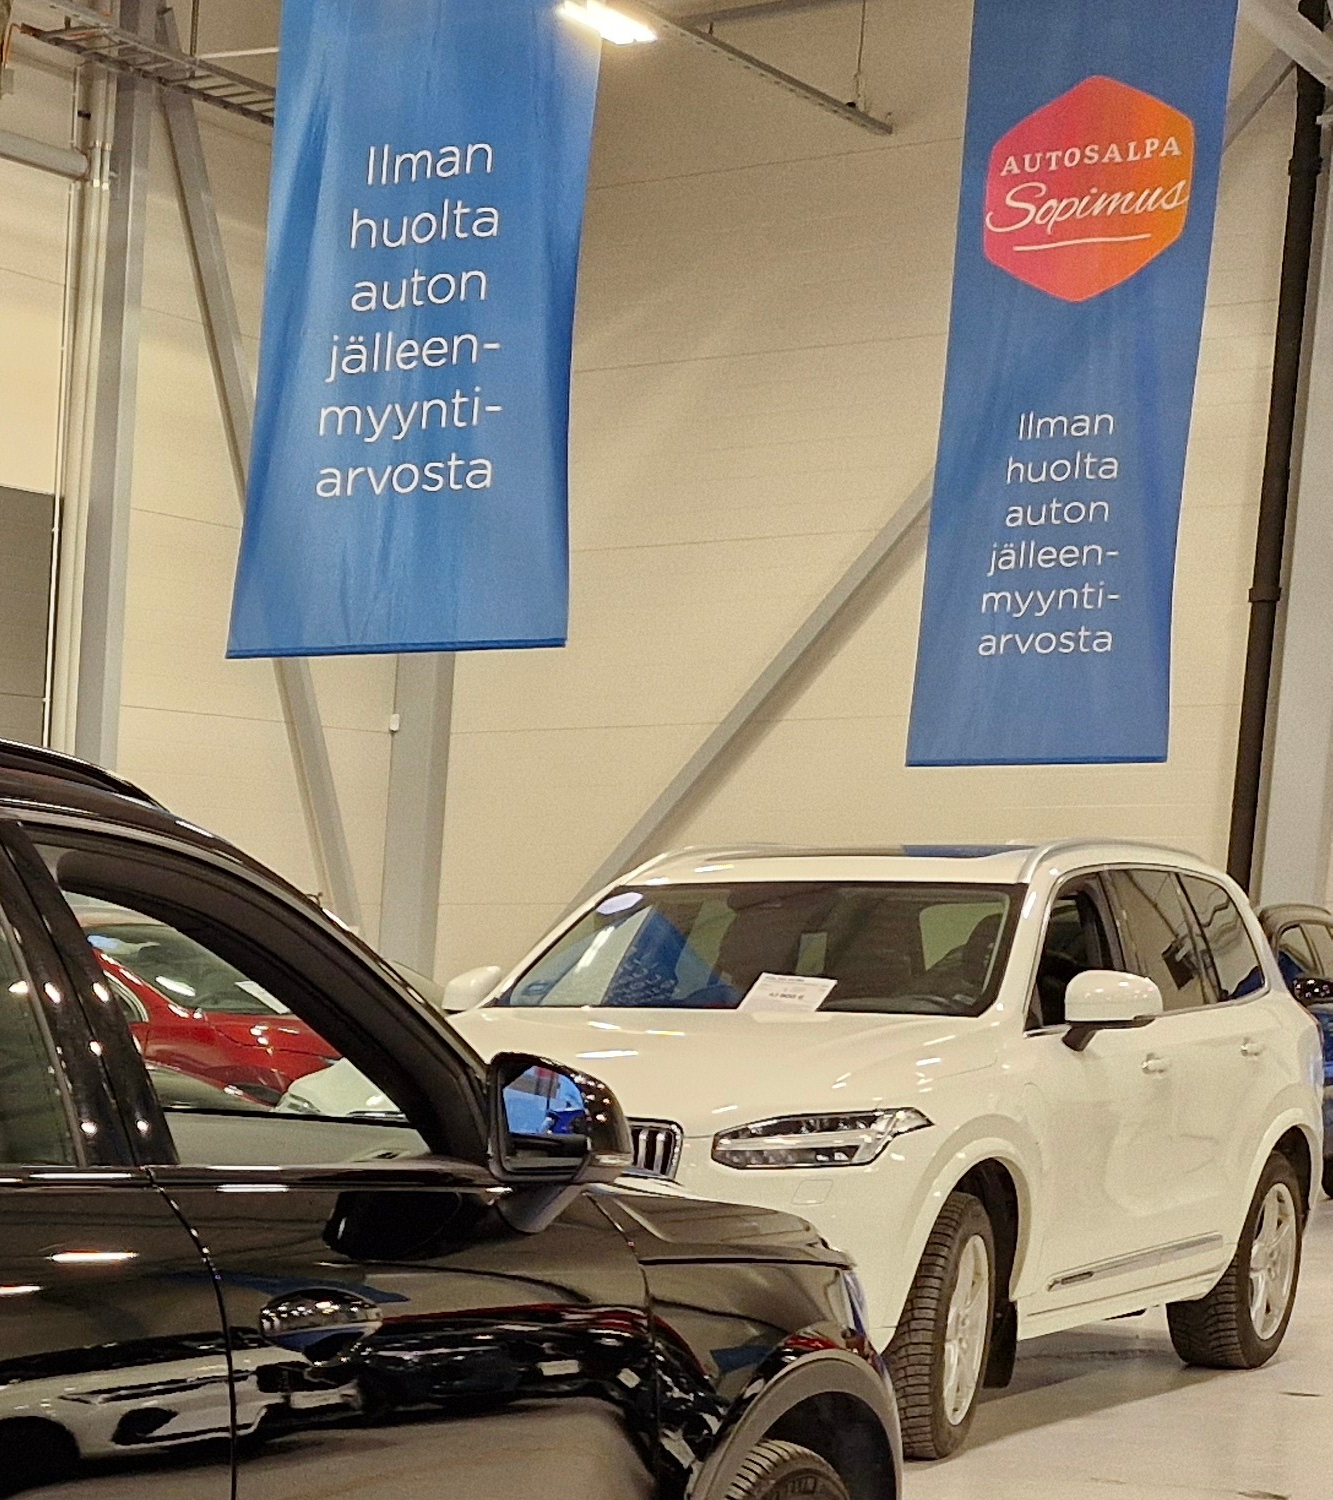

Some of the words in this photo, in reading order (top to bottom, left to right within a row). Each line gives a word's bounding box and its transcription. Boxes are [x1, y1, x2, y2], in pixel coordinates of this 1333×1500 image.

[366, 142, 493, 186] Ilman
[1000, 136, 1183, 177] AUTOSALPA
[350, 199, 500, 249] huolta
[985, 180, 1190, 236] Sopimus
[351, 268, 487, 312] auton
[324, 330, 502, 383] jälleen-
[318, 387, 504, 443] myynti-
[1018, 410, 1115, 441] Ilman
[315, 452, 493, 498] arvosta
[1006, 450, 1119, 485] huolta
[1005, 497, 1109, 528] auton
[986, 539, 1119, 577] jälleen-
[980, 581, 1120, 618] myynti-
[977, 625, 1114, 657] arvosta
